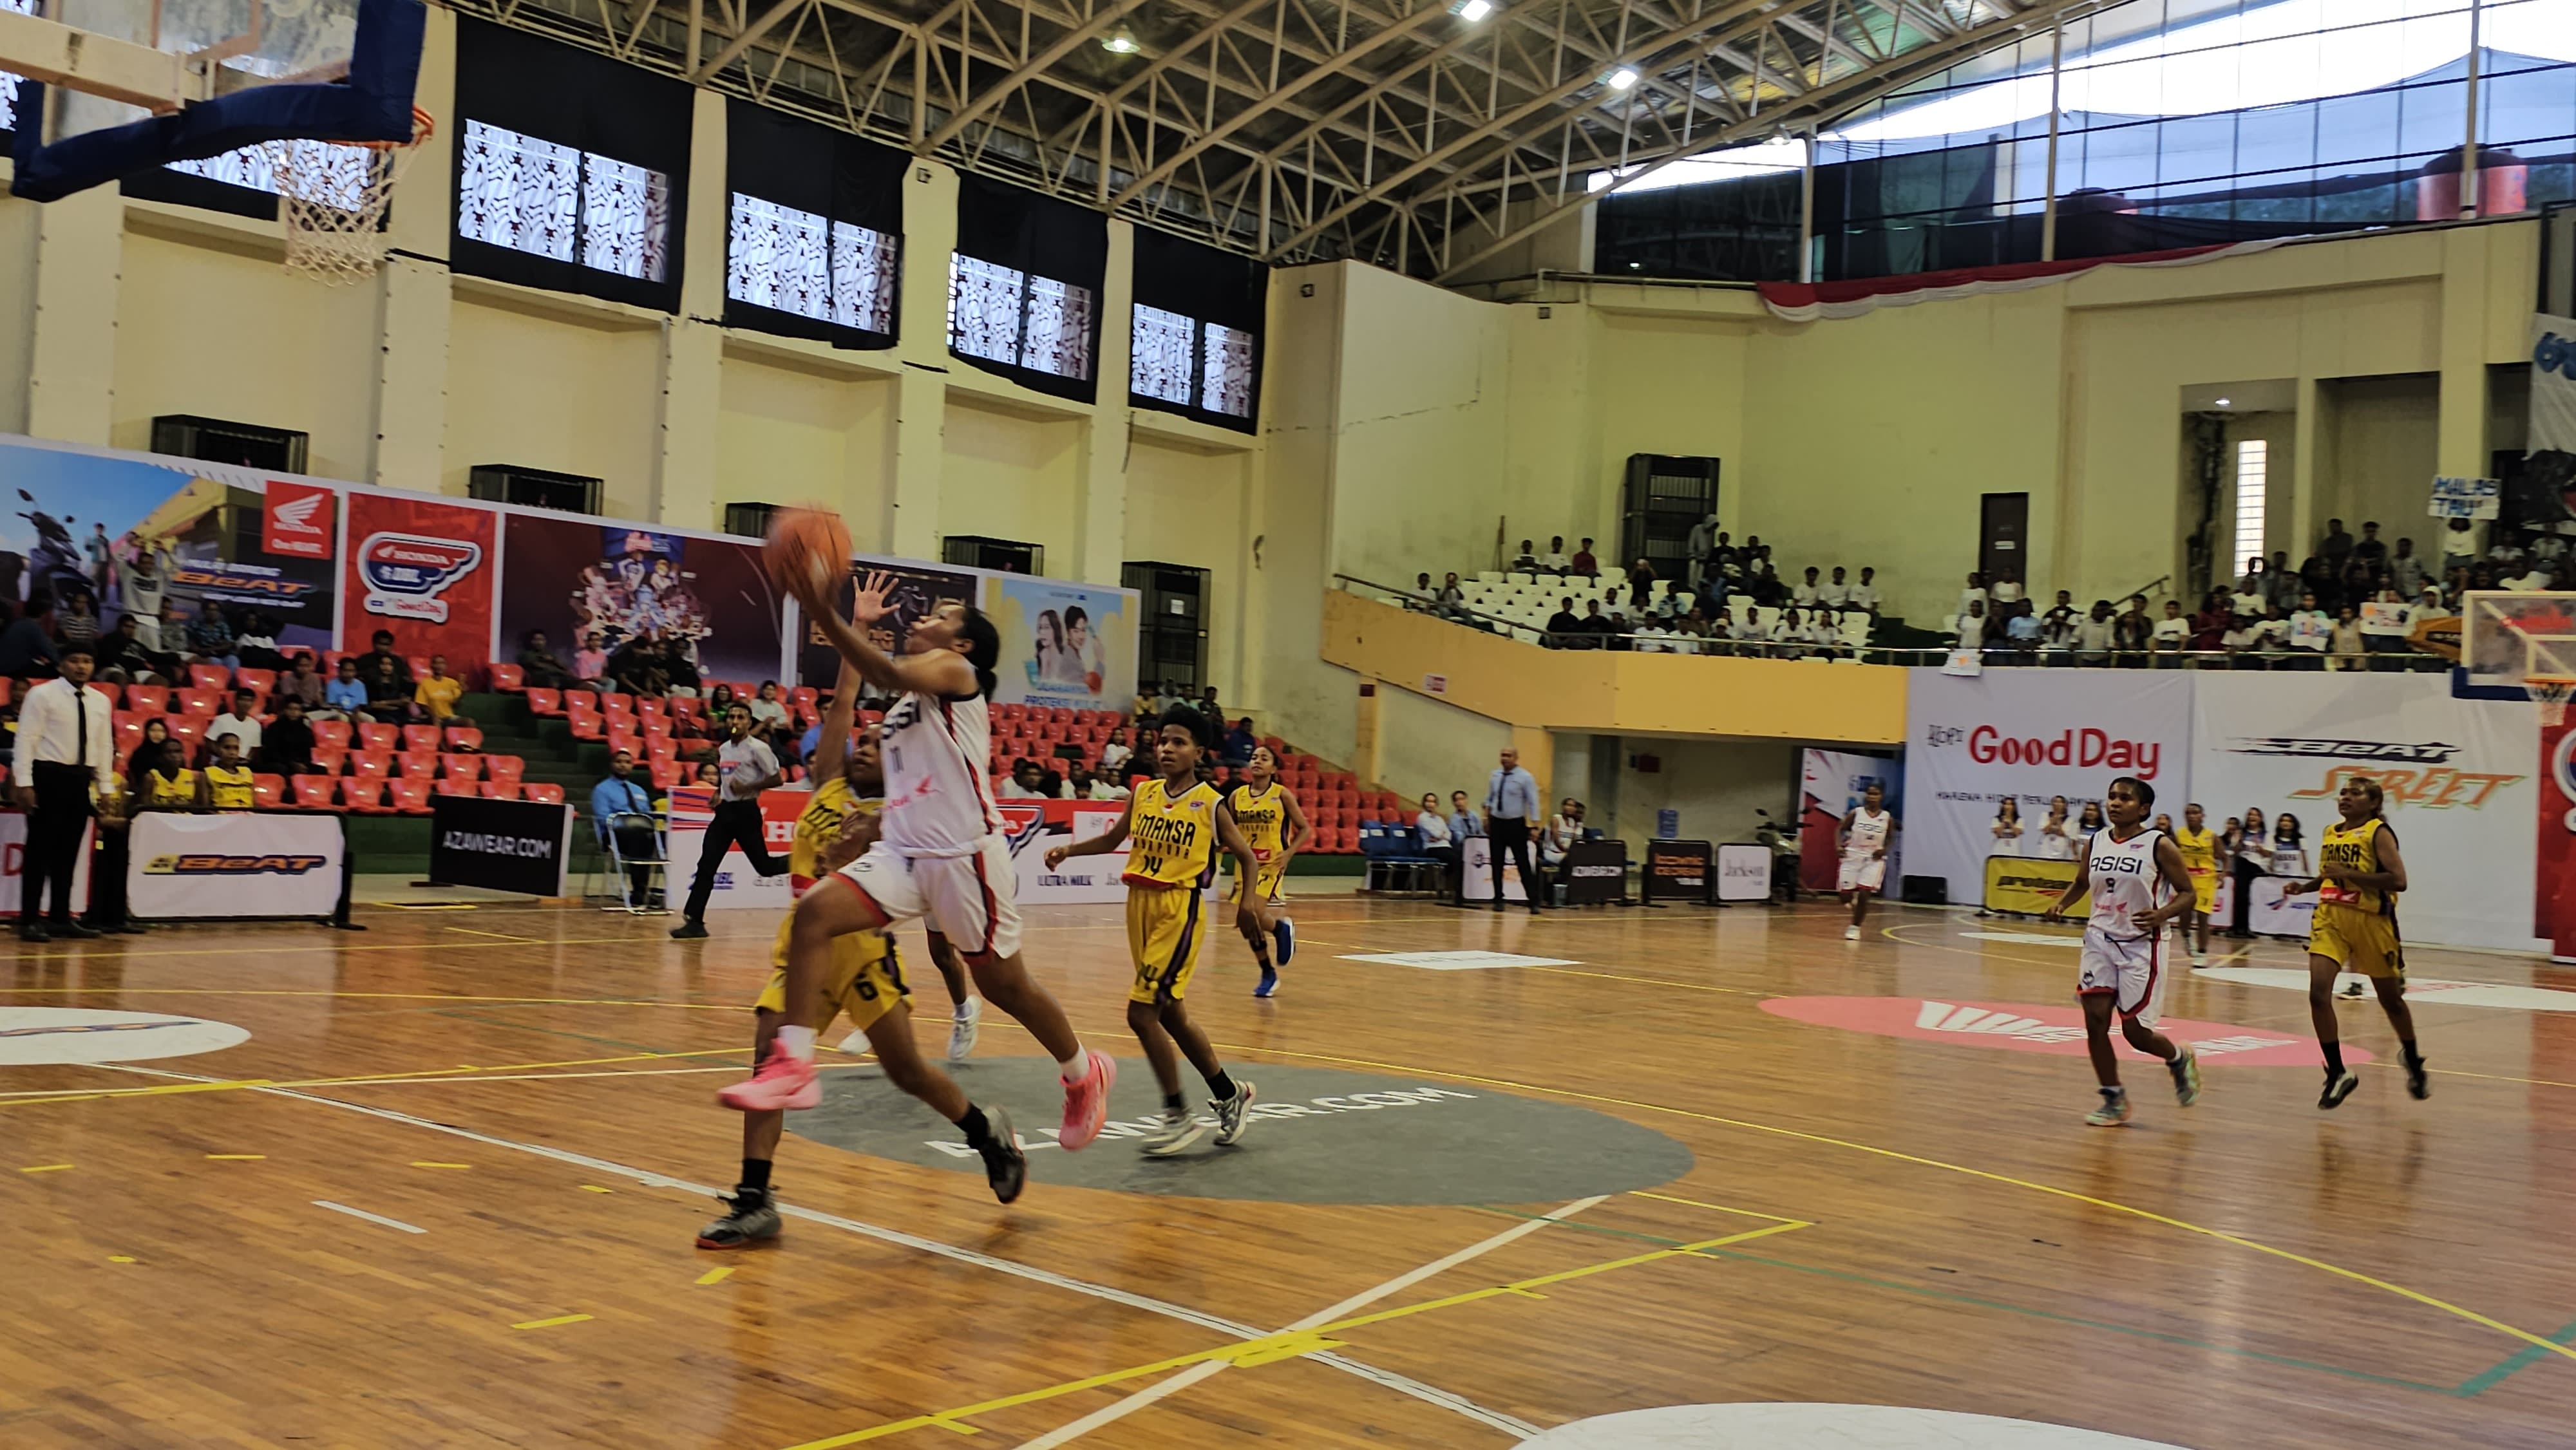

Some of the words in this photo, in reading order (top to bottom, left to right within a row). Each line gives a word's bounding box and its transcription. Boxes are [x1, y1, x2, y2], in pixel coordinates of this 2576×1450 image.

[1969, 725, 2072, 765] Good
[2078, 727, 2161, 780] Day
[177, 856, 327, 871] BeAT
[2090, 856, 2143, 875] ASISI
